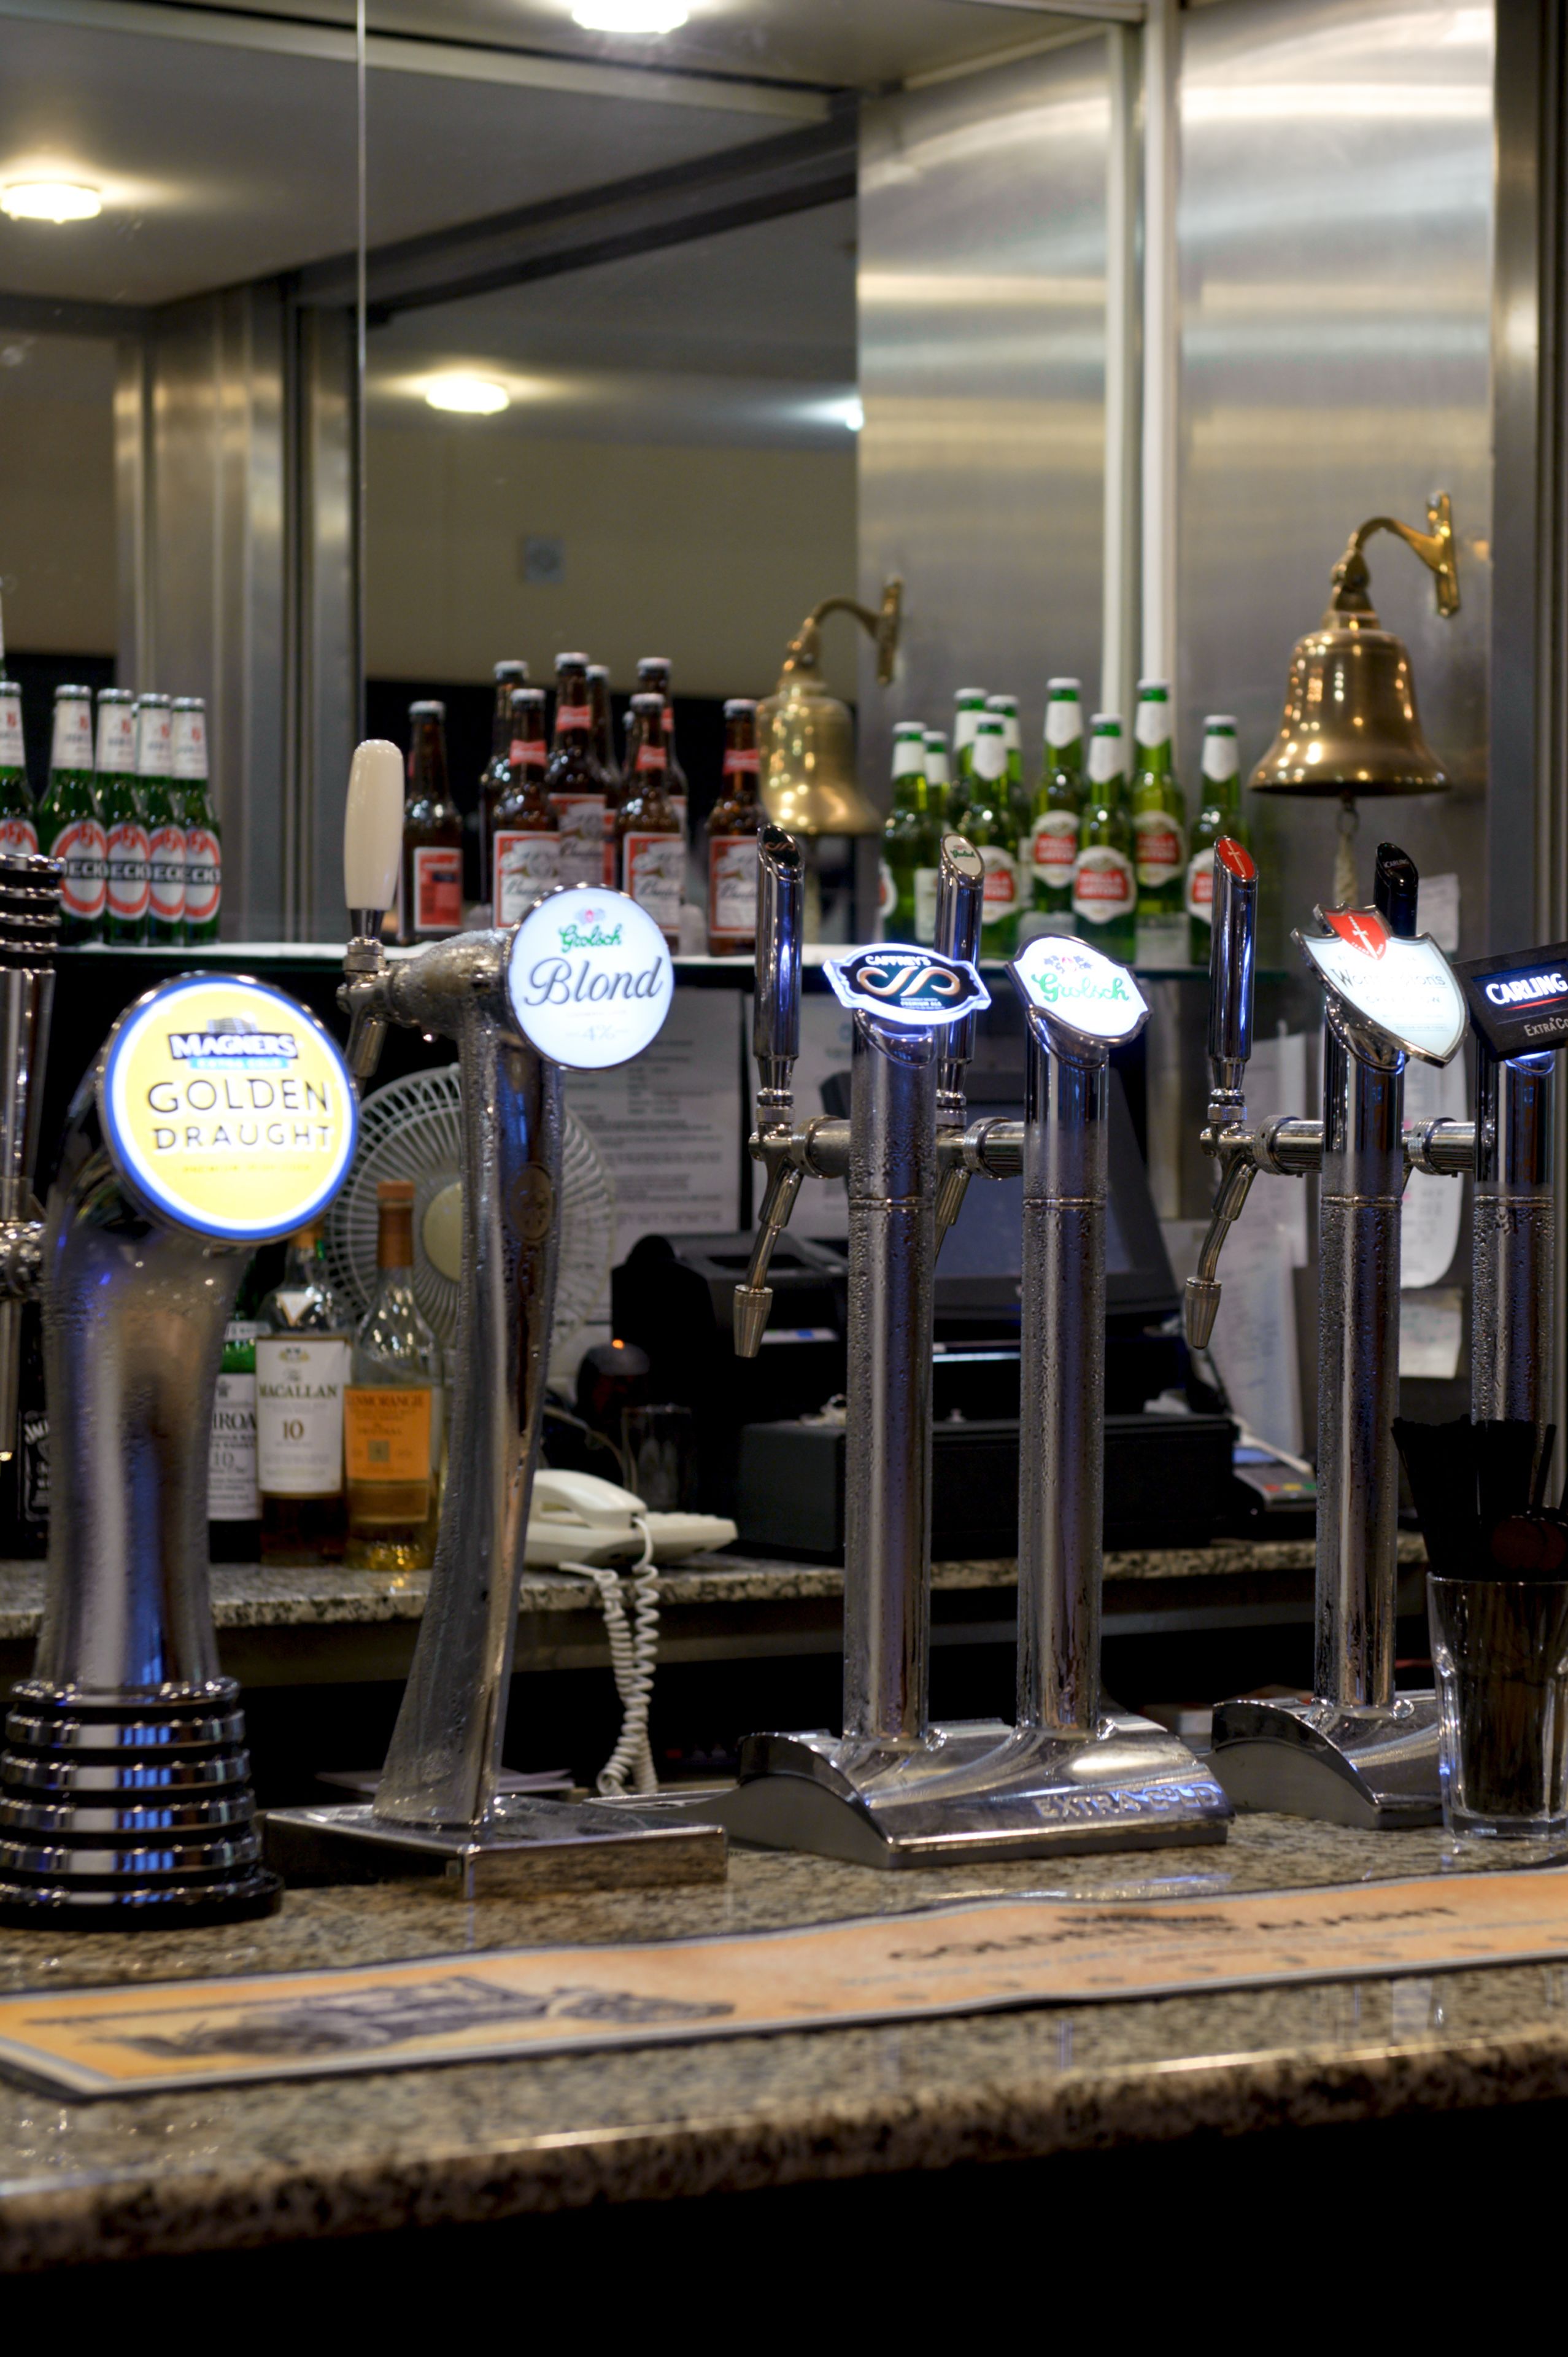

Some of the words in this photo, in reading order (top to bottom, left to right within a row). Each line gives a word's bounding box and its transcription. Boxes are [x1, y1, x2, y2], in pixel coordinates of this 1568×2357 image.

[558, 923, 622, 953] Grolsch
[865, 955, 932, 966] CAFFREY'S
[523, 956, 663, 1006] Blond
[1030, 973, 1130, 1002] Grolsch
[1486, 973, 1568, 1005] CARLING
[1524, 1021, 1557, 1037] EXTRA
[169, 1034, 298, 1058] MAGNERS
[147, 1078, 328, 1113] GOLDEN
[153, 1123, 330, 1150] DRAUGHT
[258, 1384, 338, 1398] MACALLAN
[282, 1420, 304, 1441] 10
[1032, 1790, 1141, 1818] EXTRA
[1144, 1783, 1221, 1810] COLD
